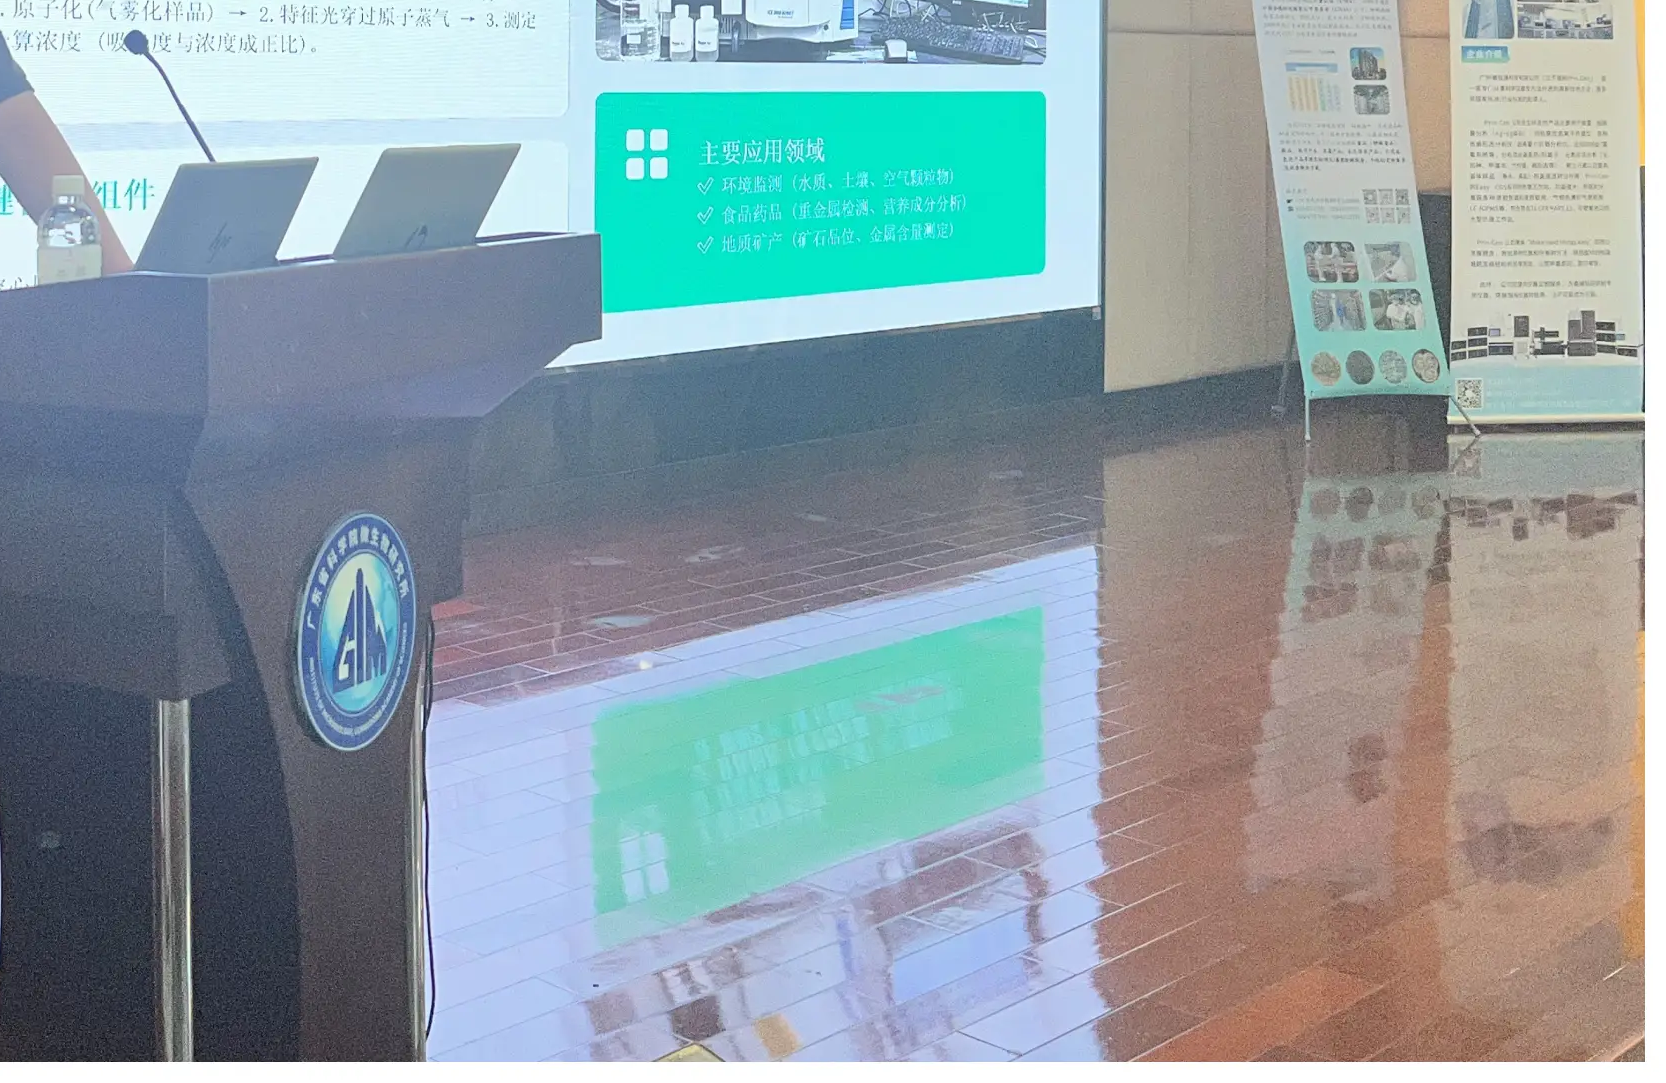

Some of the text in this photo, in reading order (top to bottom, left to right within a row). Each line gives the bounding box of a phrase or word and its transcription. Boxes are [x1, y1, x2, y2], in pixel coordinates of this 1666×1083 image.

[699, 136, 825, 166] 主要应用领域
